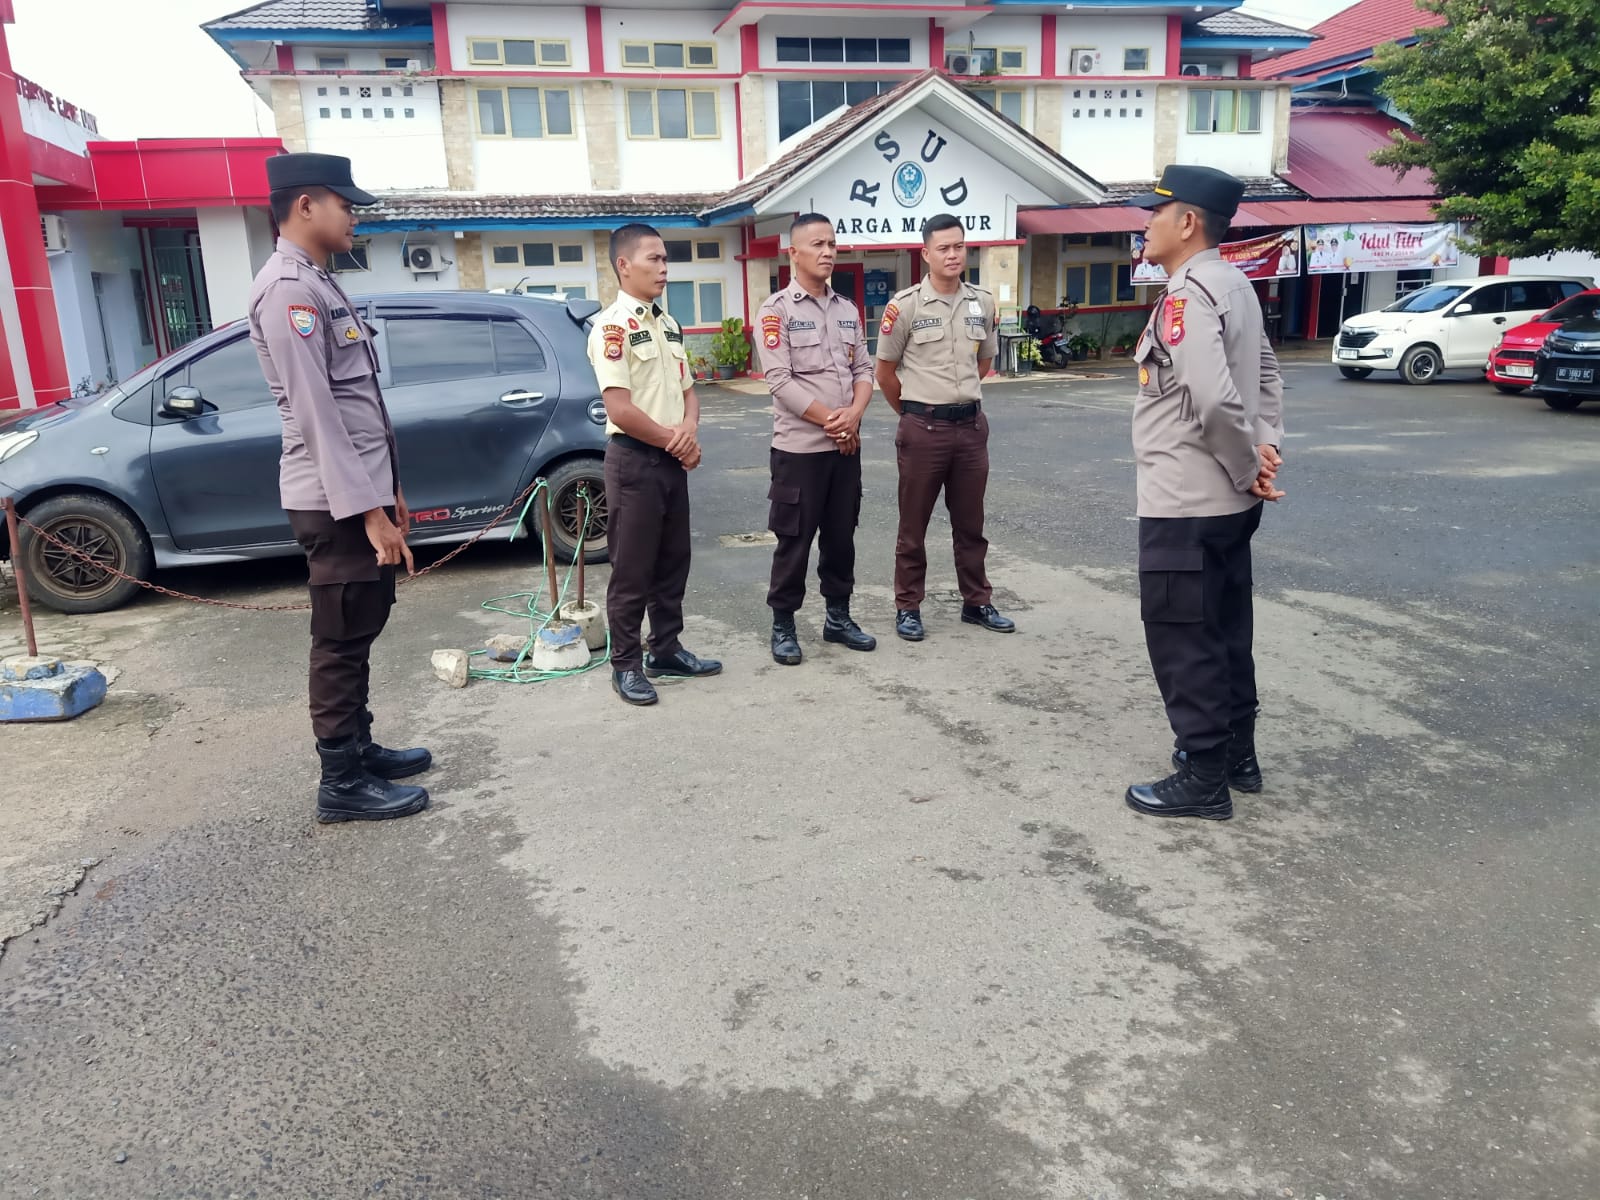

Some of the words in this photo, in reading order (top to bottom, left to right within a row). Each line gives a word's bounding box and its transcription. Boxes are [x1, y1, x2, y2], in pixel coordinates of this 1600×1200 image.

[836, 217, 892, 234] ARGA
[902, 215, 991, 233] MAUR
[1360, 232, 1391, 250] Idul
[1393, 231, 1424, 249] Fitri
